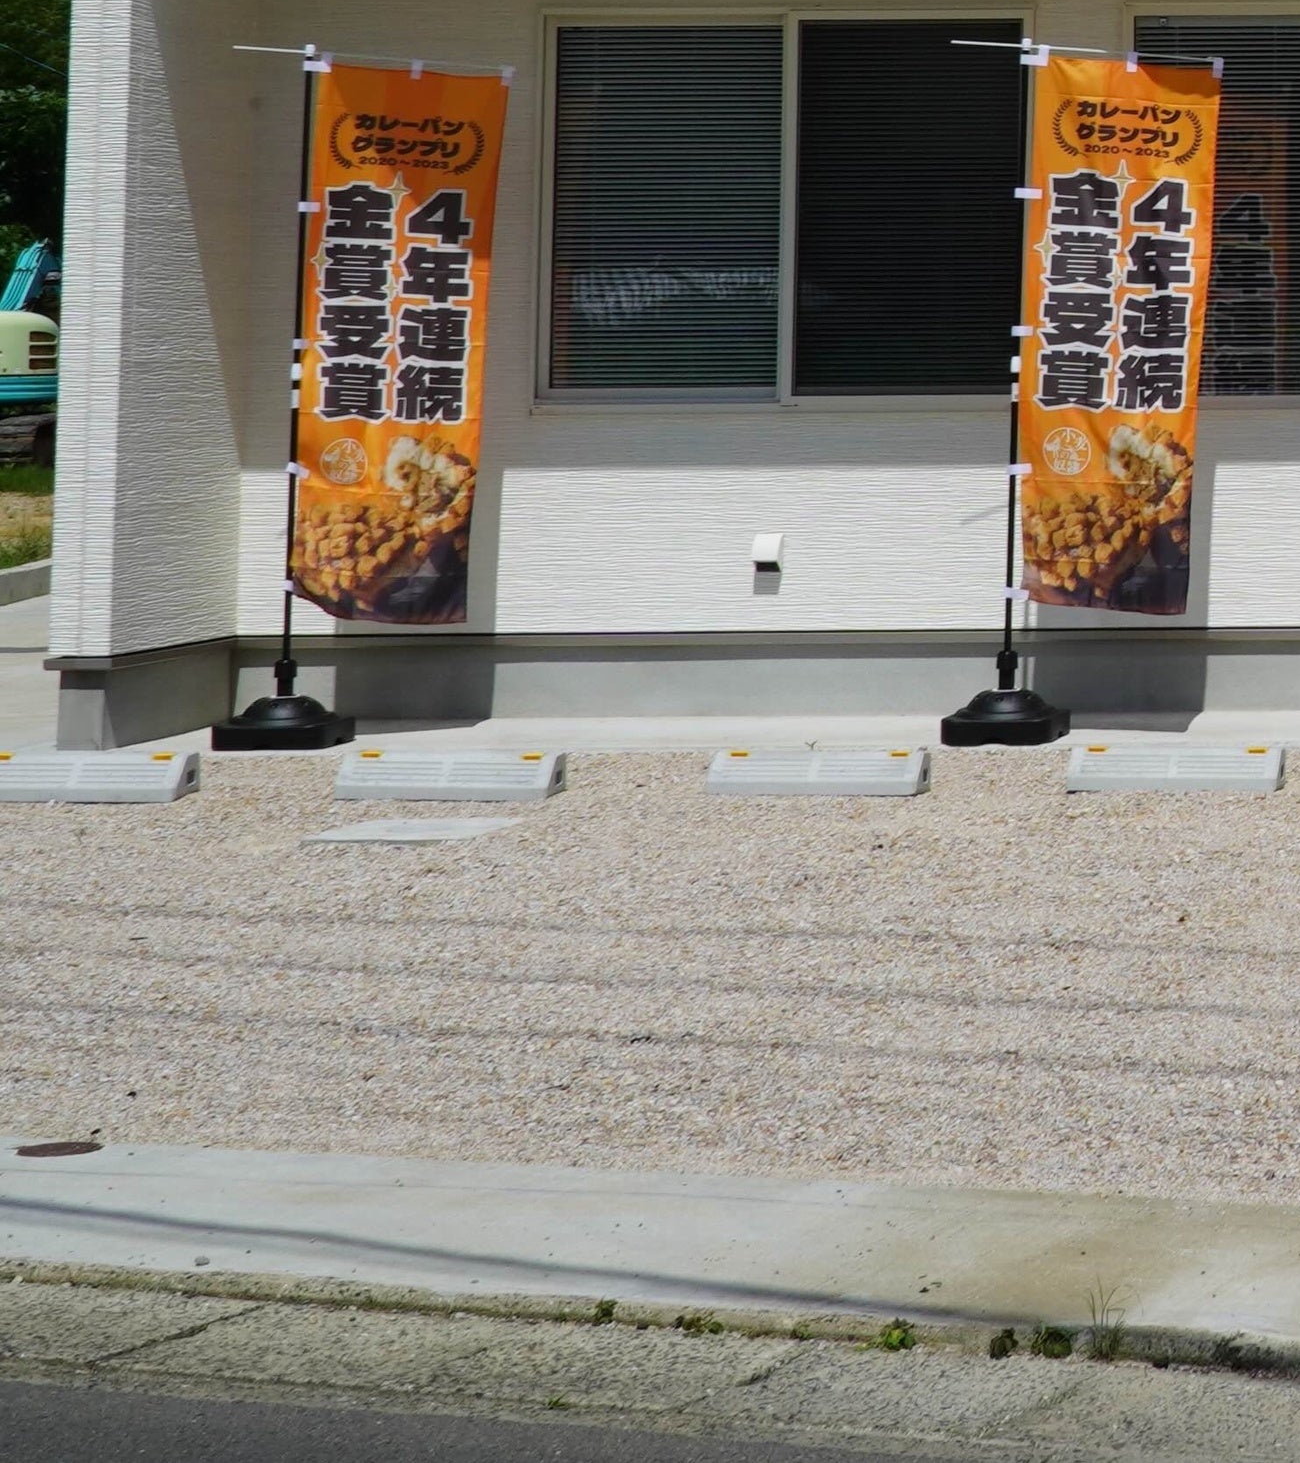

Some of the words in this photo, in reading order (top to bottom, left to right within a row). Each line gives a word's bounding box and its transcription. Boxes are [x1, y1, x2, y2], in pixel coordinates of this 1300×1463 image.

[351, 134, 461, 158] グランプリ
[354, 113, 465, 136] カレーパン
[1075, 121, 1179, 147] グランプリ
[1077, 100, 1181, 124] カレーパン
[316, 183, 395, 422] 金賞受賞
[394, 190, 473, 423] 4年連続
[1035, 171, 1121, 409] 金賞受賞
[1113, 179, 1194, 411] 4年連続
